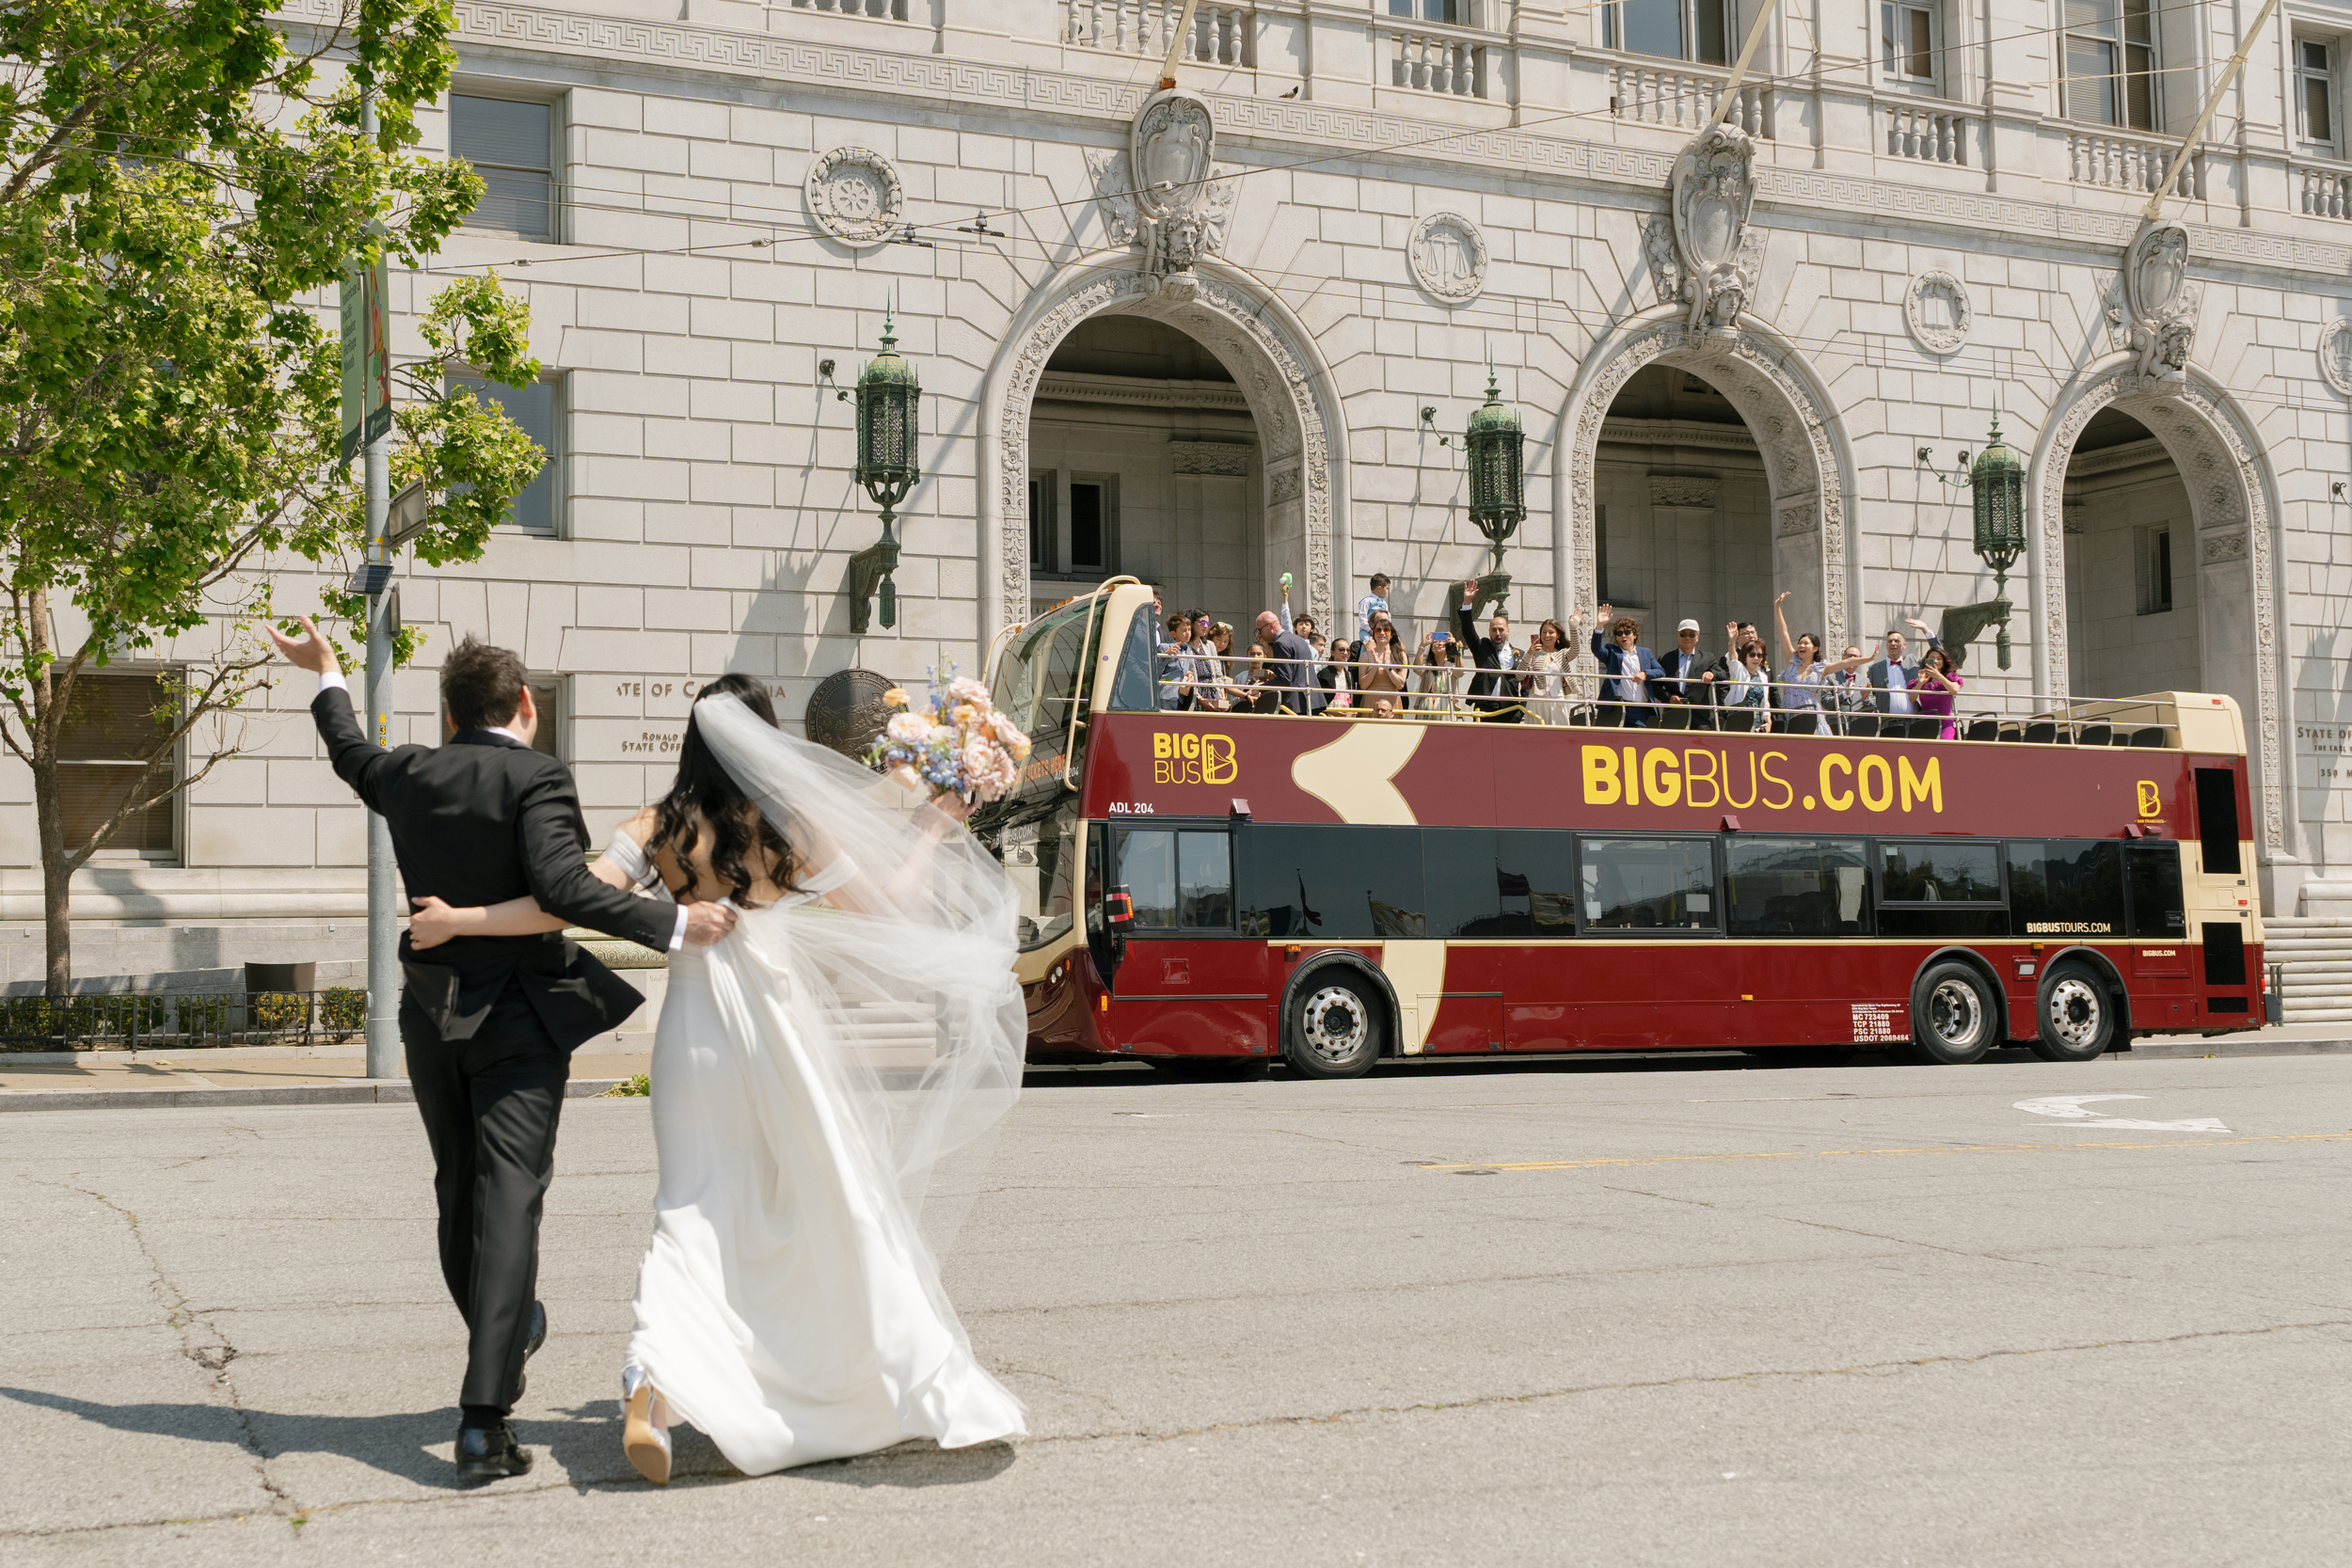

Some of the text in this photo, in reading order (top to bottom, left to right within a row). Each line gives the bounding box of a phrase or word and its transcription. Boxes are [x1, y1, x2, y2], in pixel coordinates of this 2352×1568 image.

[651, 683, 672, 697] OF
[643, 732, 678, 742] RONALD
[2297, 726, 2332, 739] STATE
[622, 740, 654, 752] STATE
[1153, 733, 1200, 759] BIG
[1025, 759, 1049, 783] TICKETS
[1050, 753, 1066, 774] HERE
[1154, 760, 1201, 784] BUS
[2320, 768, 2338, 779] 350
[1581, 745, 1943, 813] BIGBUS.COM
[1109, 801, 1154, 815] ADL 204
[2026, 922, 2111, 933] BIGBUSTOURS.COM
[2142, 949, 2176, 958] BIGBUS.COM
